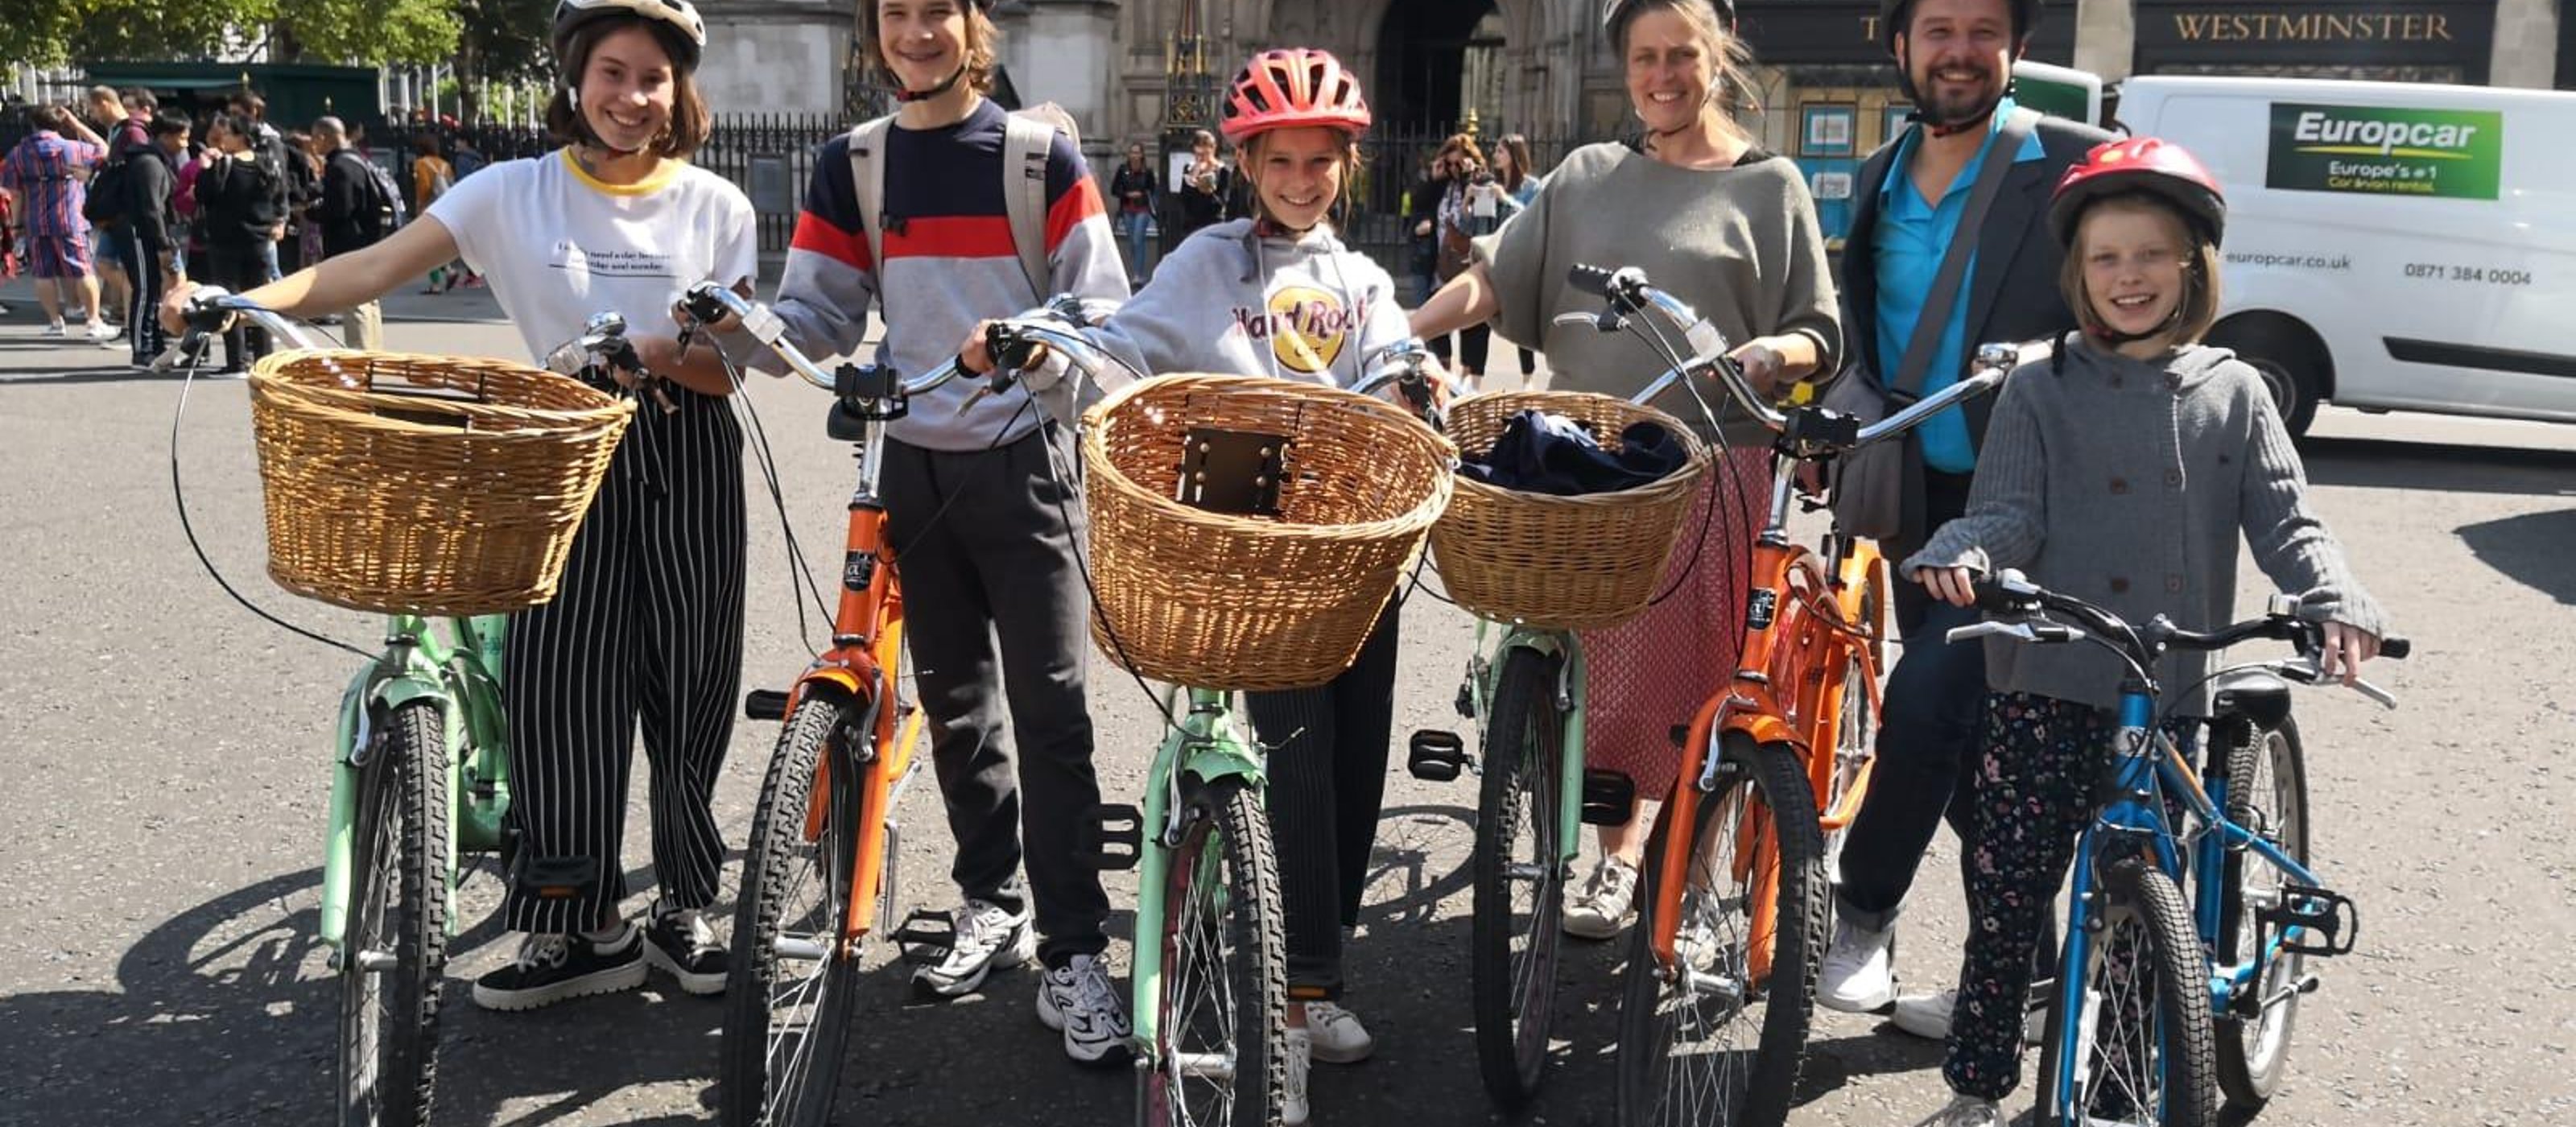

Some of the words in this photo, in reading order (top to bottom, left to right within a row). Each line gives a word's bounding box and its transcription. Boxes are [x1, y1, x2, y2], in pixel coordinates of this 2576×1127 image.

[2176, 14, 2452, 39] WESTMINSTER
[2295, 111, 2476, 155] Europcar
[2226, 252, 2351, 270] europcar.co.uk
[2405, 263, 2444, 279] 0871
[2451, 266, 2482, 282] 384
[2488, 269, 2531, 285] 0004
